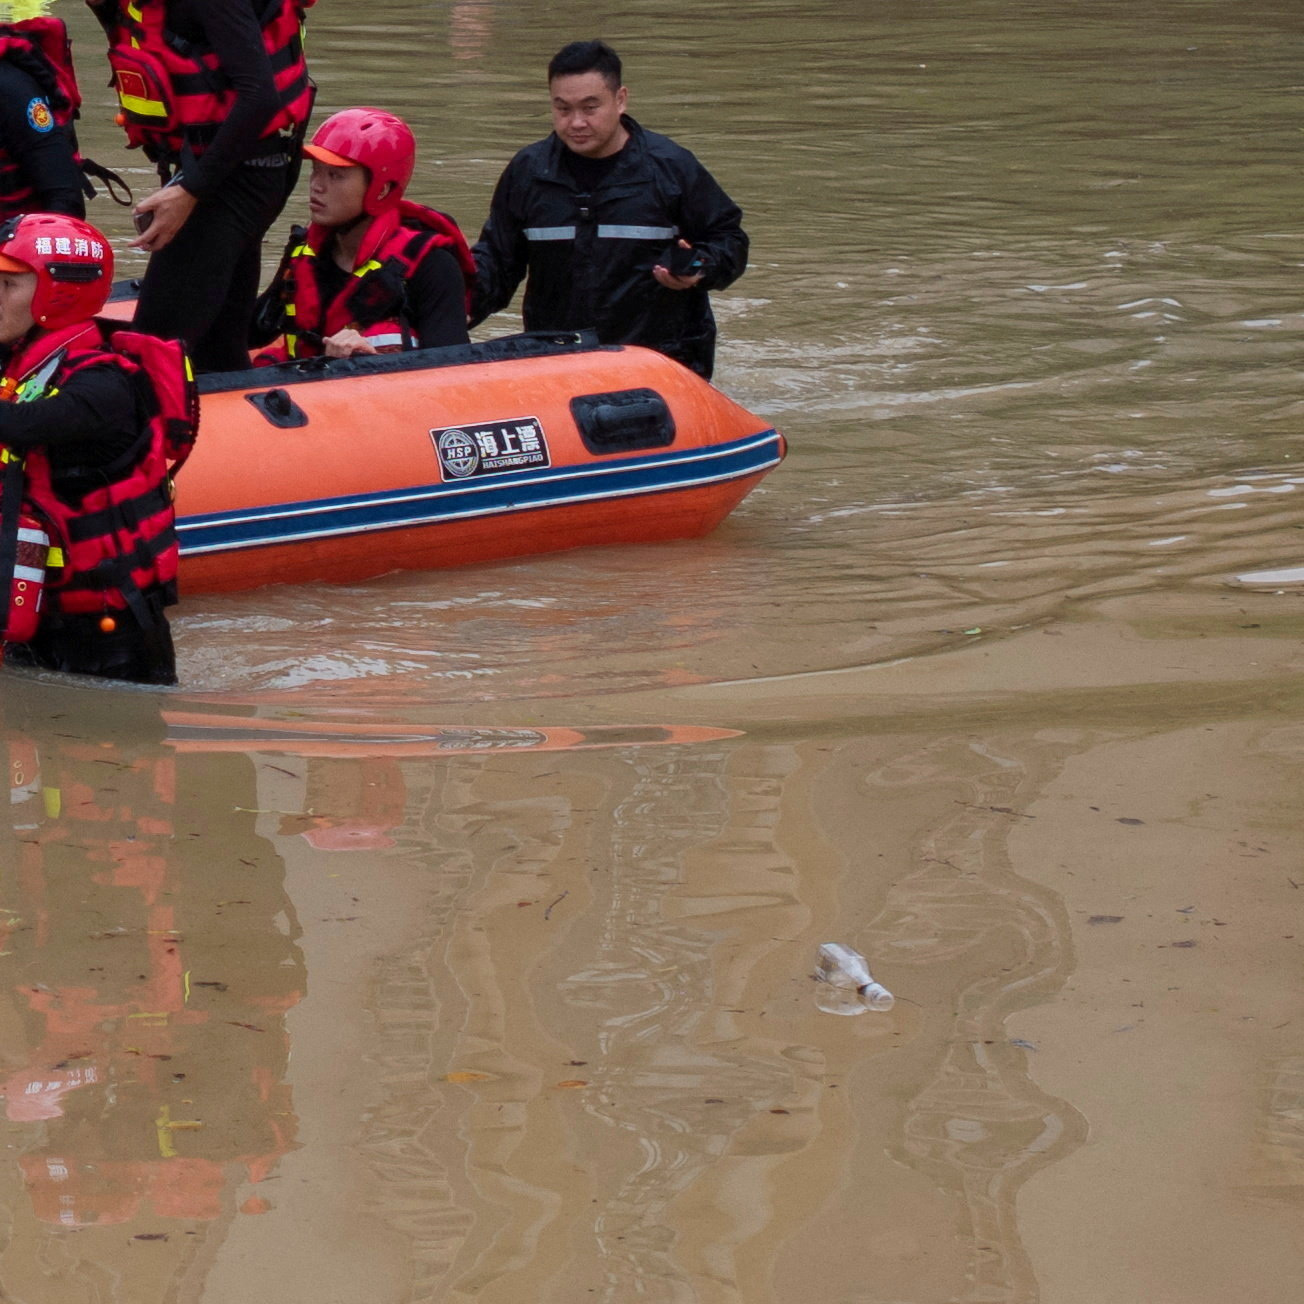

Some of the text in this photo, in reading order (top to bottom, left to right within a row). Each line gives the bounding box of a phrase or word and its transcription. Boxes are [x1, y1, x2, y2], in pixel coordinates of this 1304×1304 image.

[35, 237, 104, 260] 福建消防
[474, 424, 541, 458] 海上漂
[446, 446, 472, 460] HSP
[482, 453, 544, 470] HAISHANGPIAO
